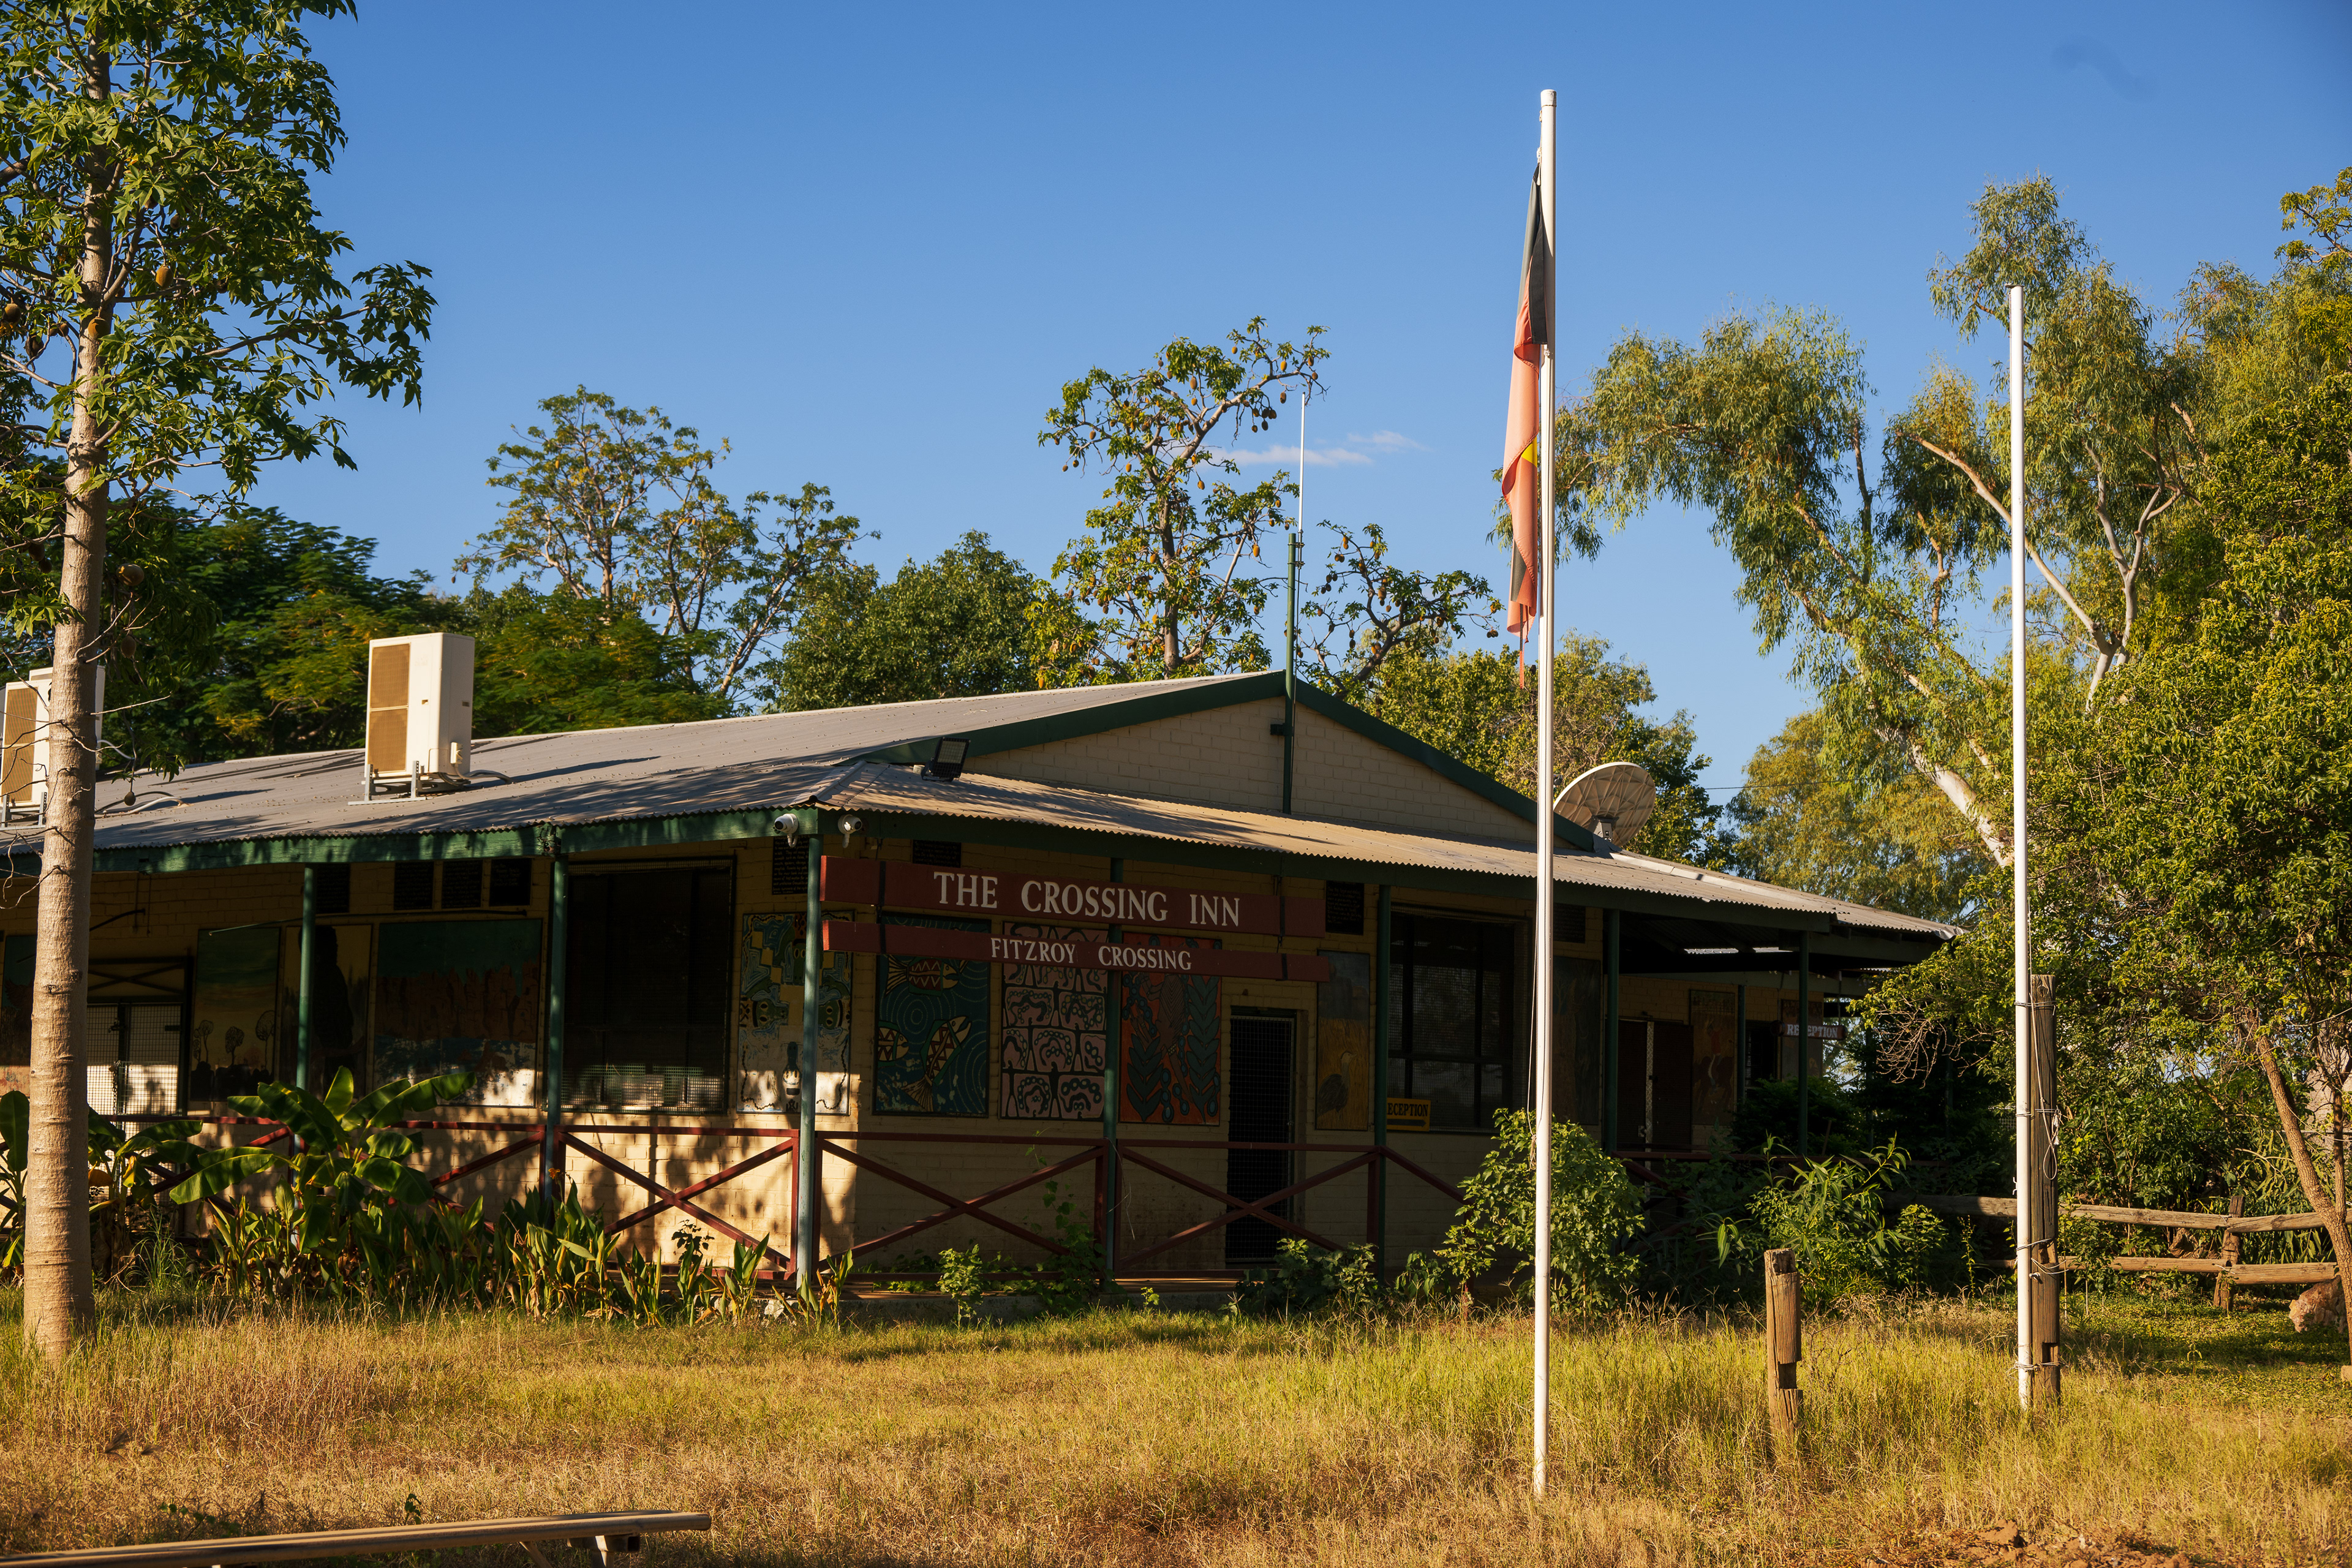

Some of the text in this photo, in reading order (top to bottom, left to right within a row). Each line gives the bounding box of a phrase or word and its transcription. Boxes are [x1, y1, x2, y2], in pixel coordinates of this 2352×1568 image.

[933, 872, 1240, 927] THE CROSSING INN
[990, 938, 1192, 970] FITZROY CROSSING
[1787, 1024, 1838, 1038] REEPTION
[1387, 1102, 1429, 1117] ECEPTION
